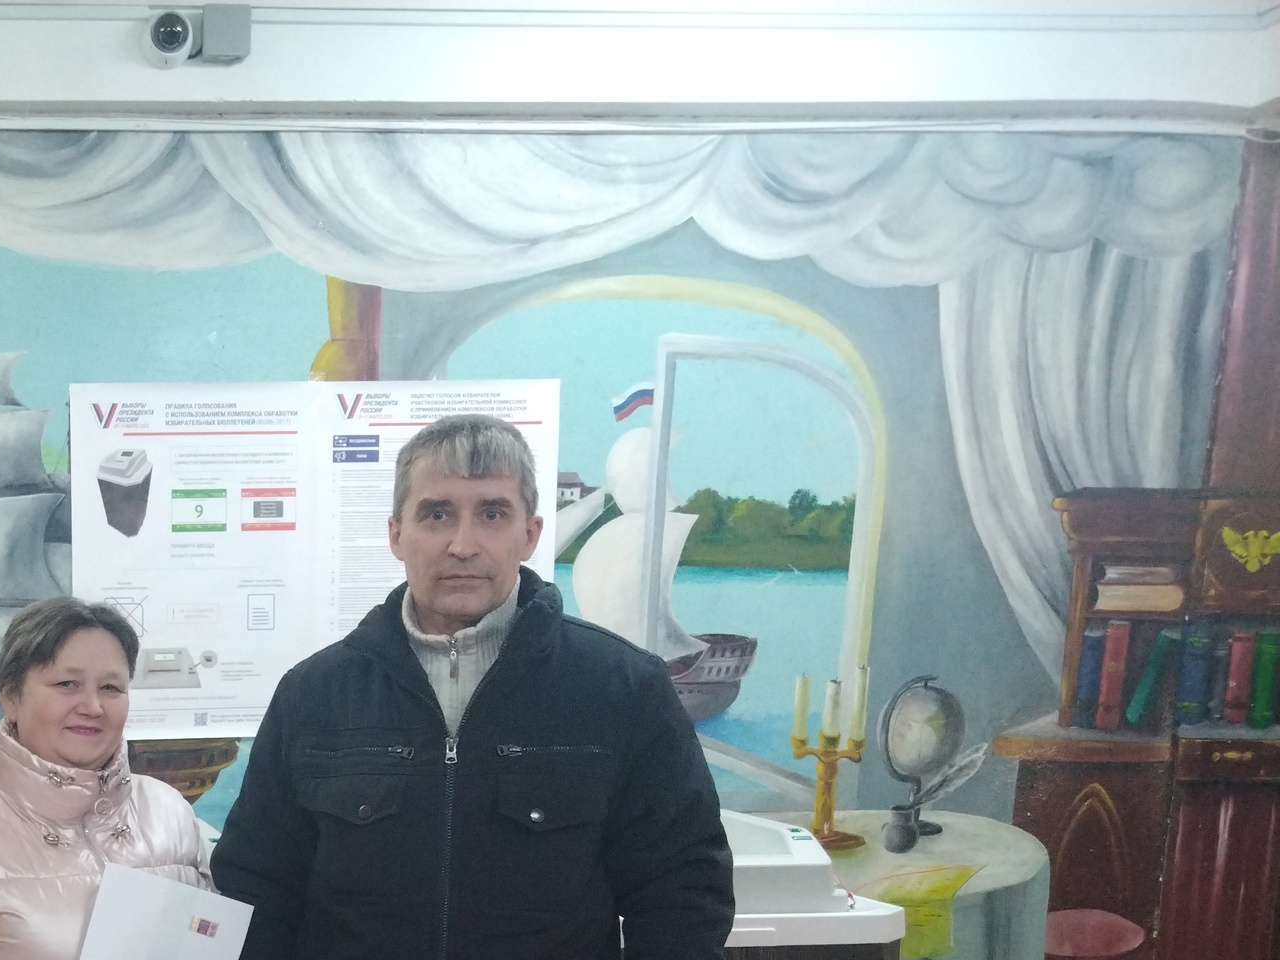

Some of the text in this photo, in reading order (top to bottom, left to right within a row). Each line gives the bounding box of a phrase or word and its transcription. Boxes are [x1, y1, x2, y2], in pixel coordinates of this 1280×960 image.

[164, 419, 216, 427] ИЗБИРАТЕЛЬНЫХ
[216, 418, 256, 426] БЮЛЛЕТЕНЕЙ
[194, 504, 204, 518] 9
